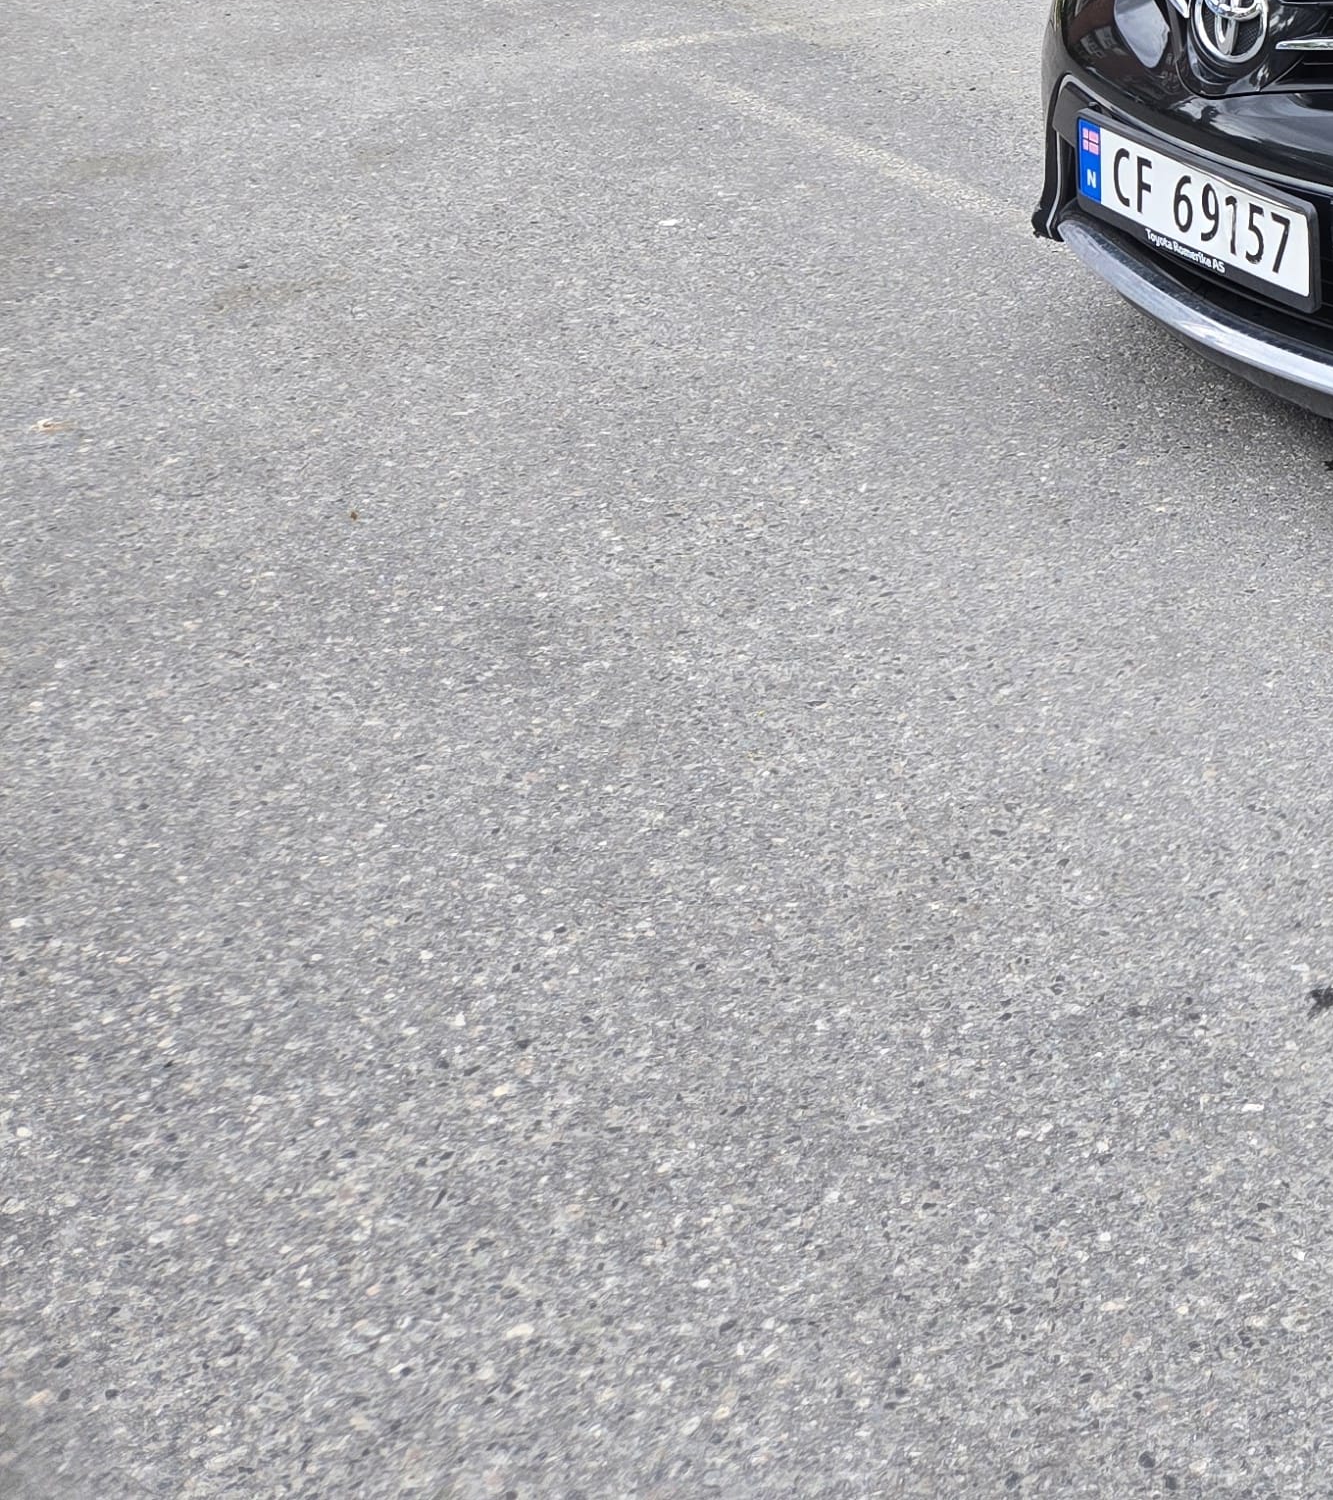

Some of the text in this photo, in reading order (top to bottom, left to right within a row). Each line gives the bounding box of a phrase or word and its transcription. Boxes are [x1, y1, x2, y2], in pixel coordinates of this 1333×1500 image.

[1086, 169, 1097, 189] N
[1113, 147, 1292, 274] CF 69157
[1145, 228, 1173, 250] Toyota
[1212, 258, 1226, 274] AS
